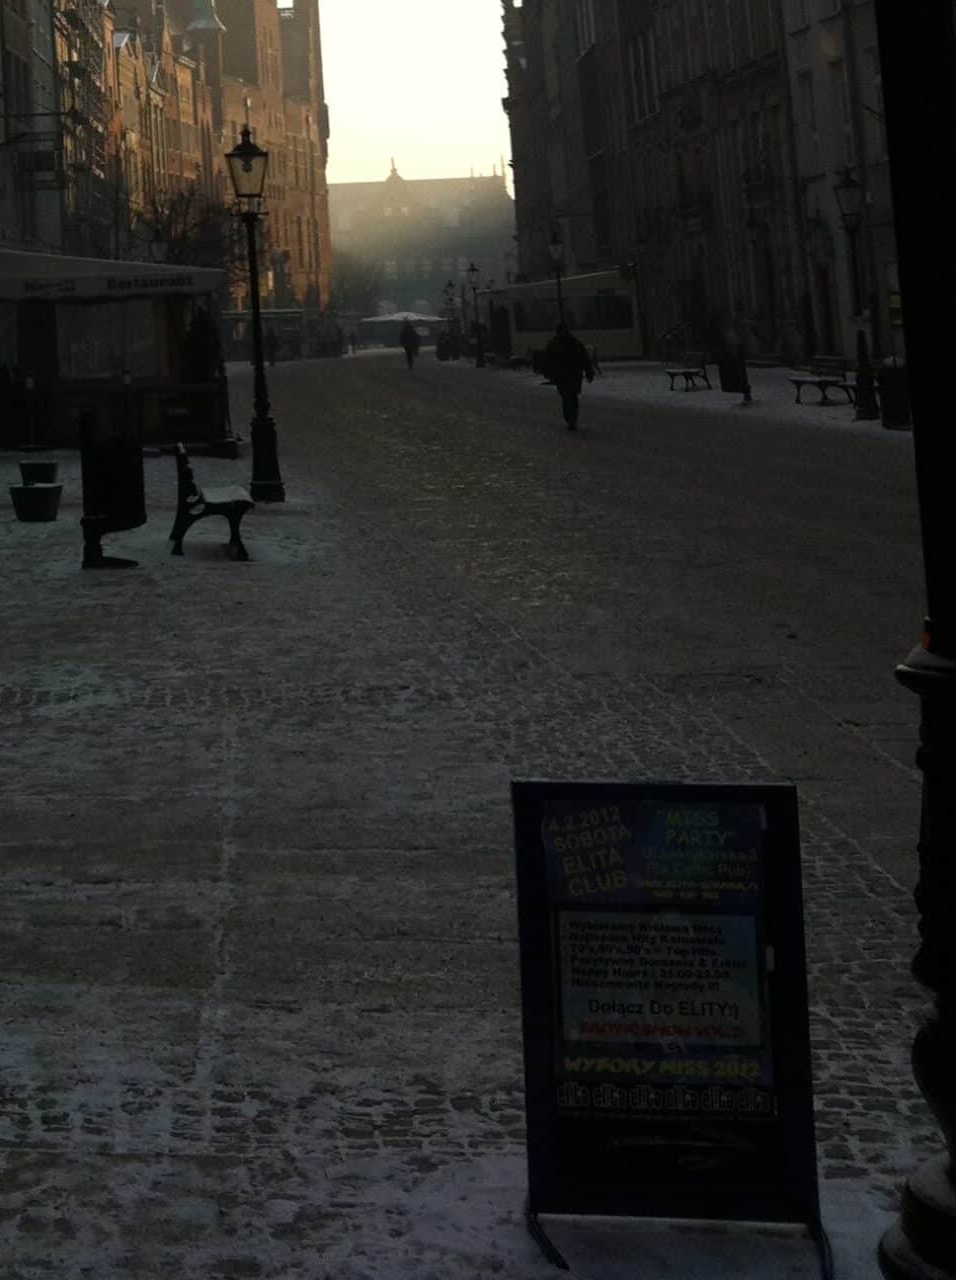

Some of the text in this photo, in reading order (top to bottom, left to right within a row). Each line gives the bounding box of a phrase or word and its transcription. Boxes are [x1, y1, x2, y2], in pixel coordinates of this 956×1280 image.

[553, 824, 631, 852] SOBOTA
[563, 848, 626, 875] ELITA
[569, 870, 628, 897] CLUB
[588, 999, 644, 1018] Dołącz
[650, 1000, 675, 1015] Do
